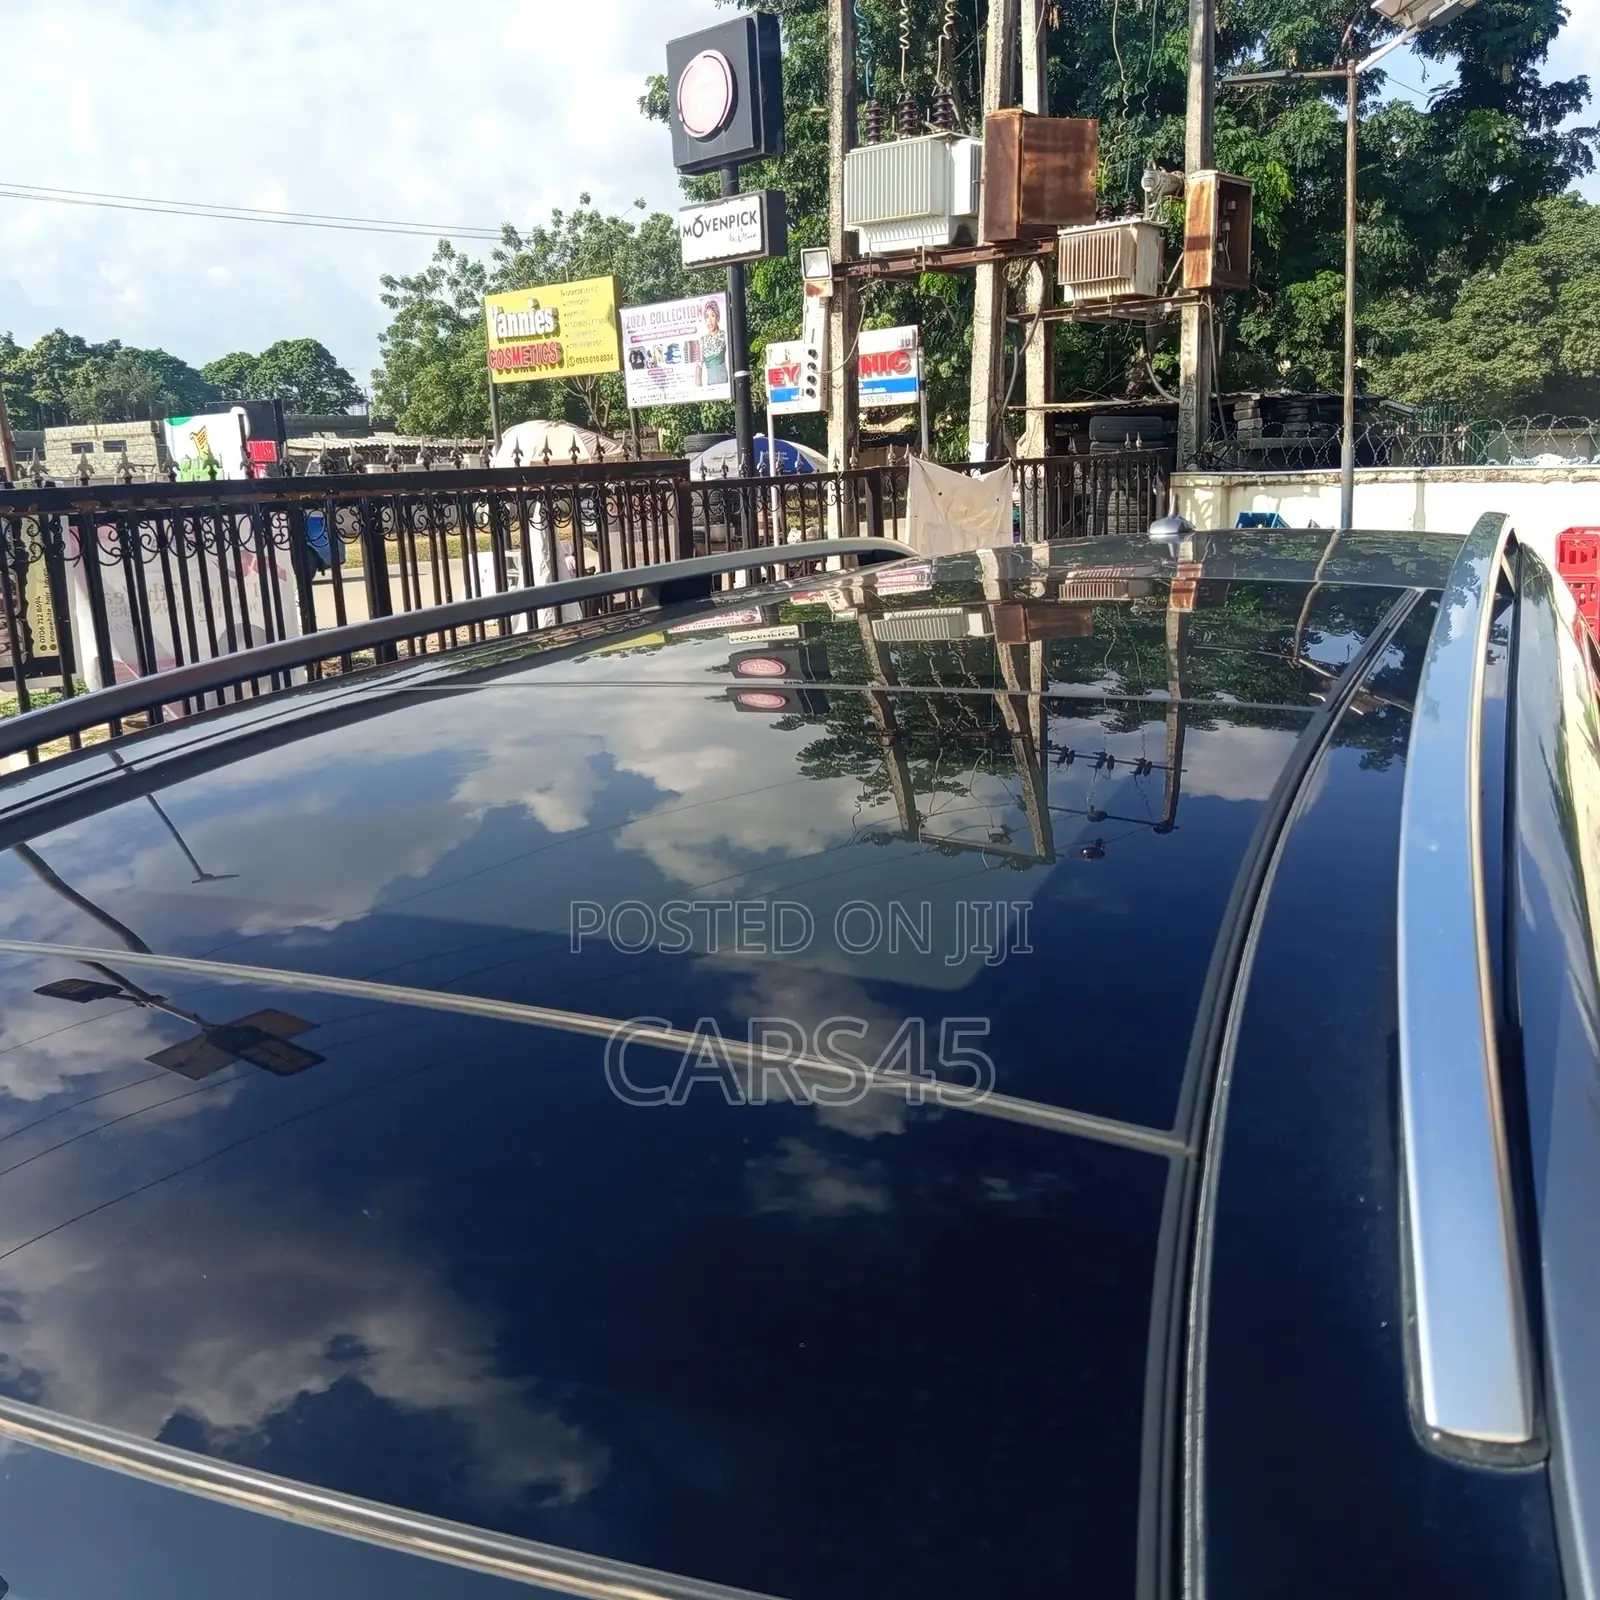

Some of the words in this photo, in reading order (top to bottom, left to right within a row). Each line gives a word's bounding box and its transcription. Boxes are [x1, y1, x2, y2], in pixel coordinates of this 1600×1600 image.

[487, 297, 557, 339] Yannies
[626, 313, 647, 329] ZOZA
[650, 304, 702, 325] COLLECTION
[488, 342, 558, 369] COSMETICS
[768, 364, 800, 386] EY
[858, 350, 910, 375] NIC
